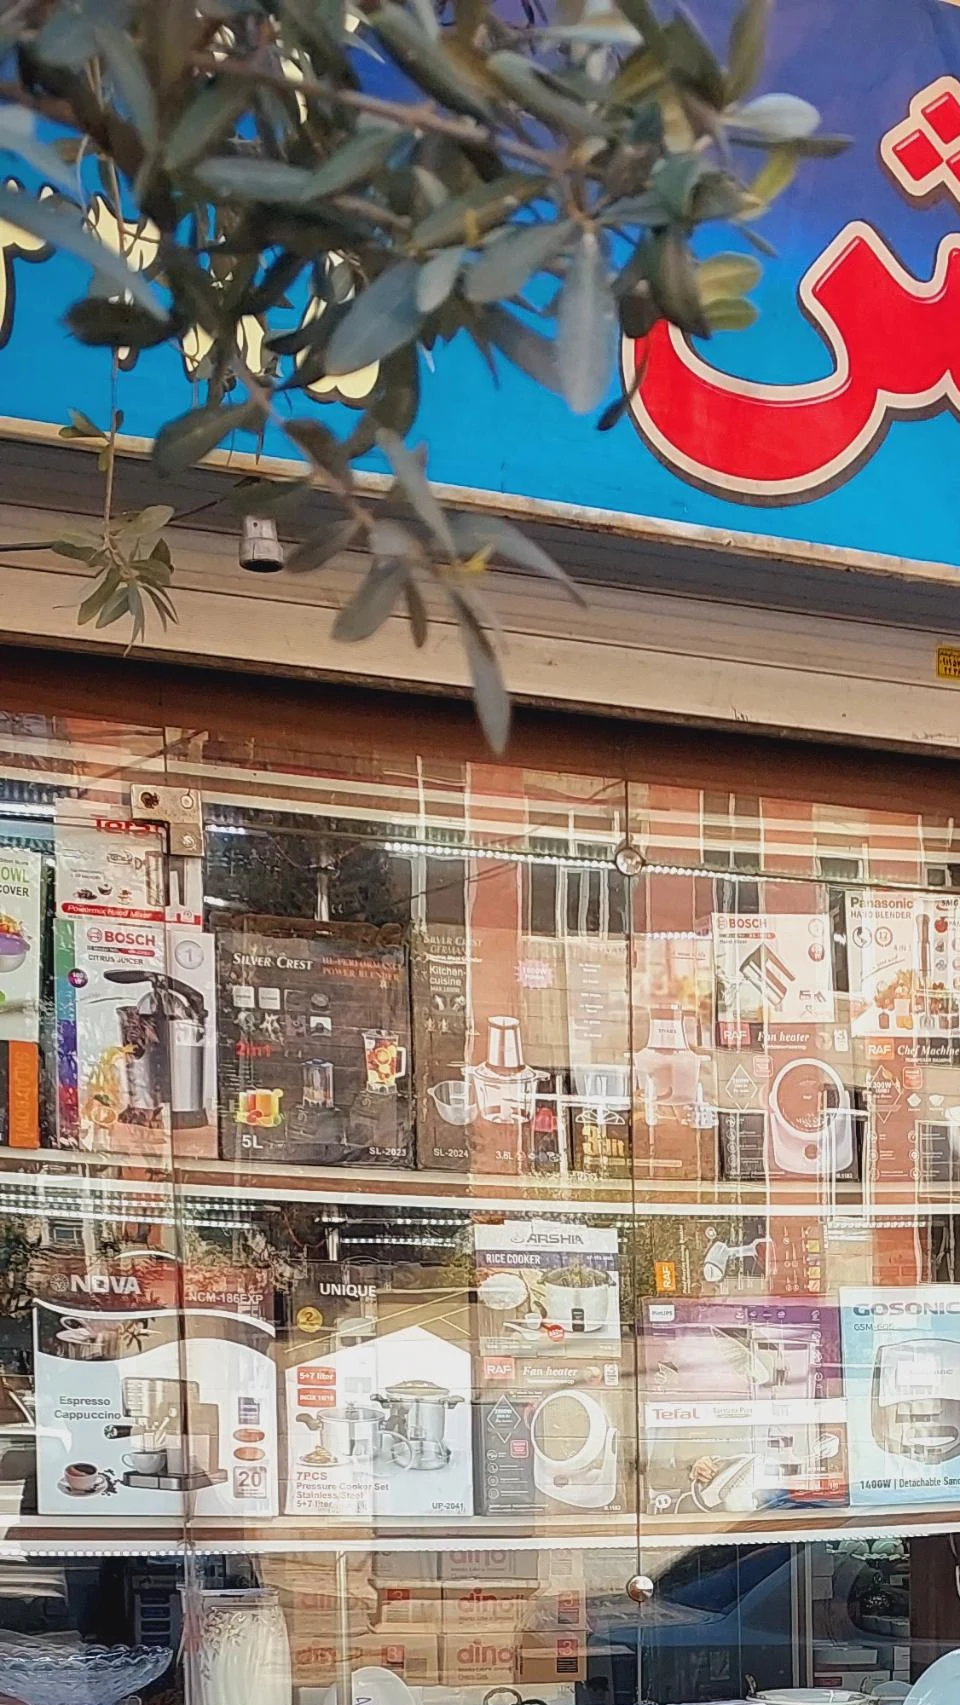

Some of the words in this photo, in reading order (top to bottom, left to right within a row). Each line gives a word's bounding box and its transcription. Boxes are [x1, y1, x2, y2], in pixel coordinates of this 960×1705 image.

[0, 867, 30, 883] OWL
[850, 897, 914, 909] Panasonic
[874, 911, 912, 920] BLENDER
[729, 918, 767, 929] BOSCH
[104, 929, 156, 947] BOSCH
[232, 952, 272, 968] SILVER
[276, 954, 313, 970] CREST
[723, 1029, 748, 1040] RAF
[779, 1030, 810, 1042] heater
[868, 1044, 892, 1055] RAF
[897, 1044, 920, 1056] Chef
[921, 1045, 960, 1056] Machine
[241, 1134, 263, 1150] 5L
[526, 1233, 585, 1245] ARSHIA
[486, 1253, 506, 1264] RICE
[506, 1254, 541, 1265] COOKER
[662, 1267, 671, 1288] RAF
[71, 1275, 142, 1294] NOVA
[319, 1282, 377, 1298] UNIQUE
[853, 1301, 960, 1317] GOSONIC
[486, 1364, 512, 1374] RAF
[522, 1367, 543, 1377] Fan
[544, 1367, 578, 1377] heater
[59, 1396, 111, 1407] Espresso
[54, 1409, 122, 1421] Cappuccino
[652, 1408, 701, 1421] Tefal
[238, 1471, 261, 1488] 20
[860, 1478, 892, 1490] 1400W
[899, 1477, 941, 1488] Detachable
[374, 1482, 389, 1491] Set
[458, 1587, 514, 1618] dino
[457, 1639, 514, 1665] dino
